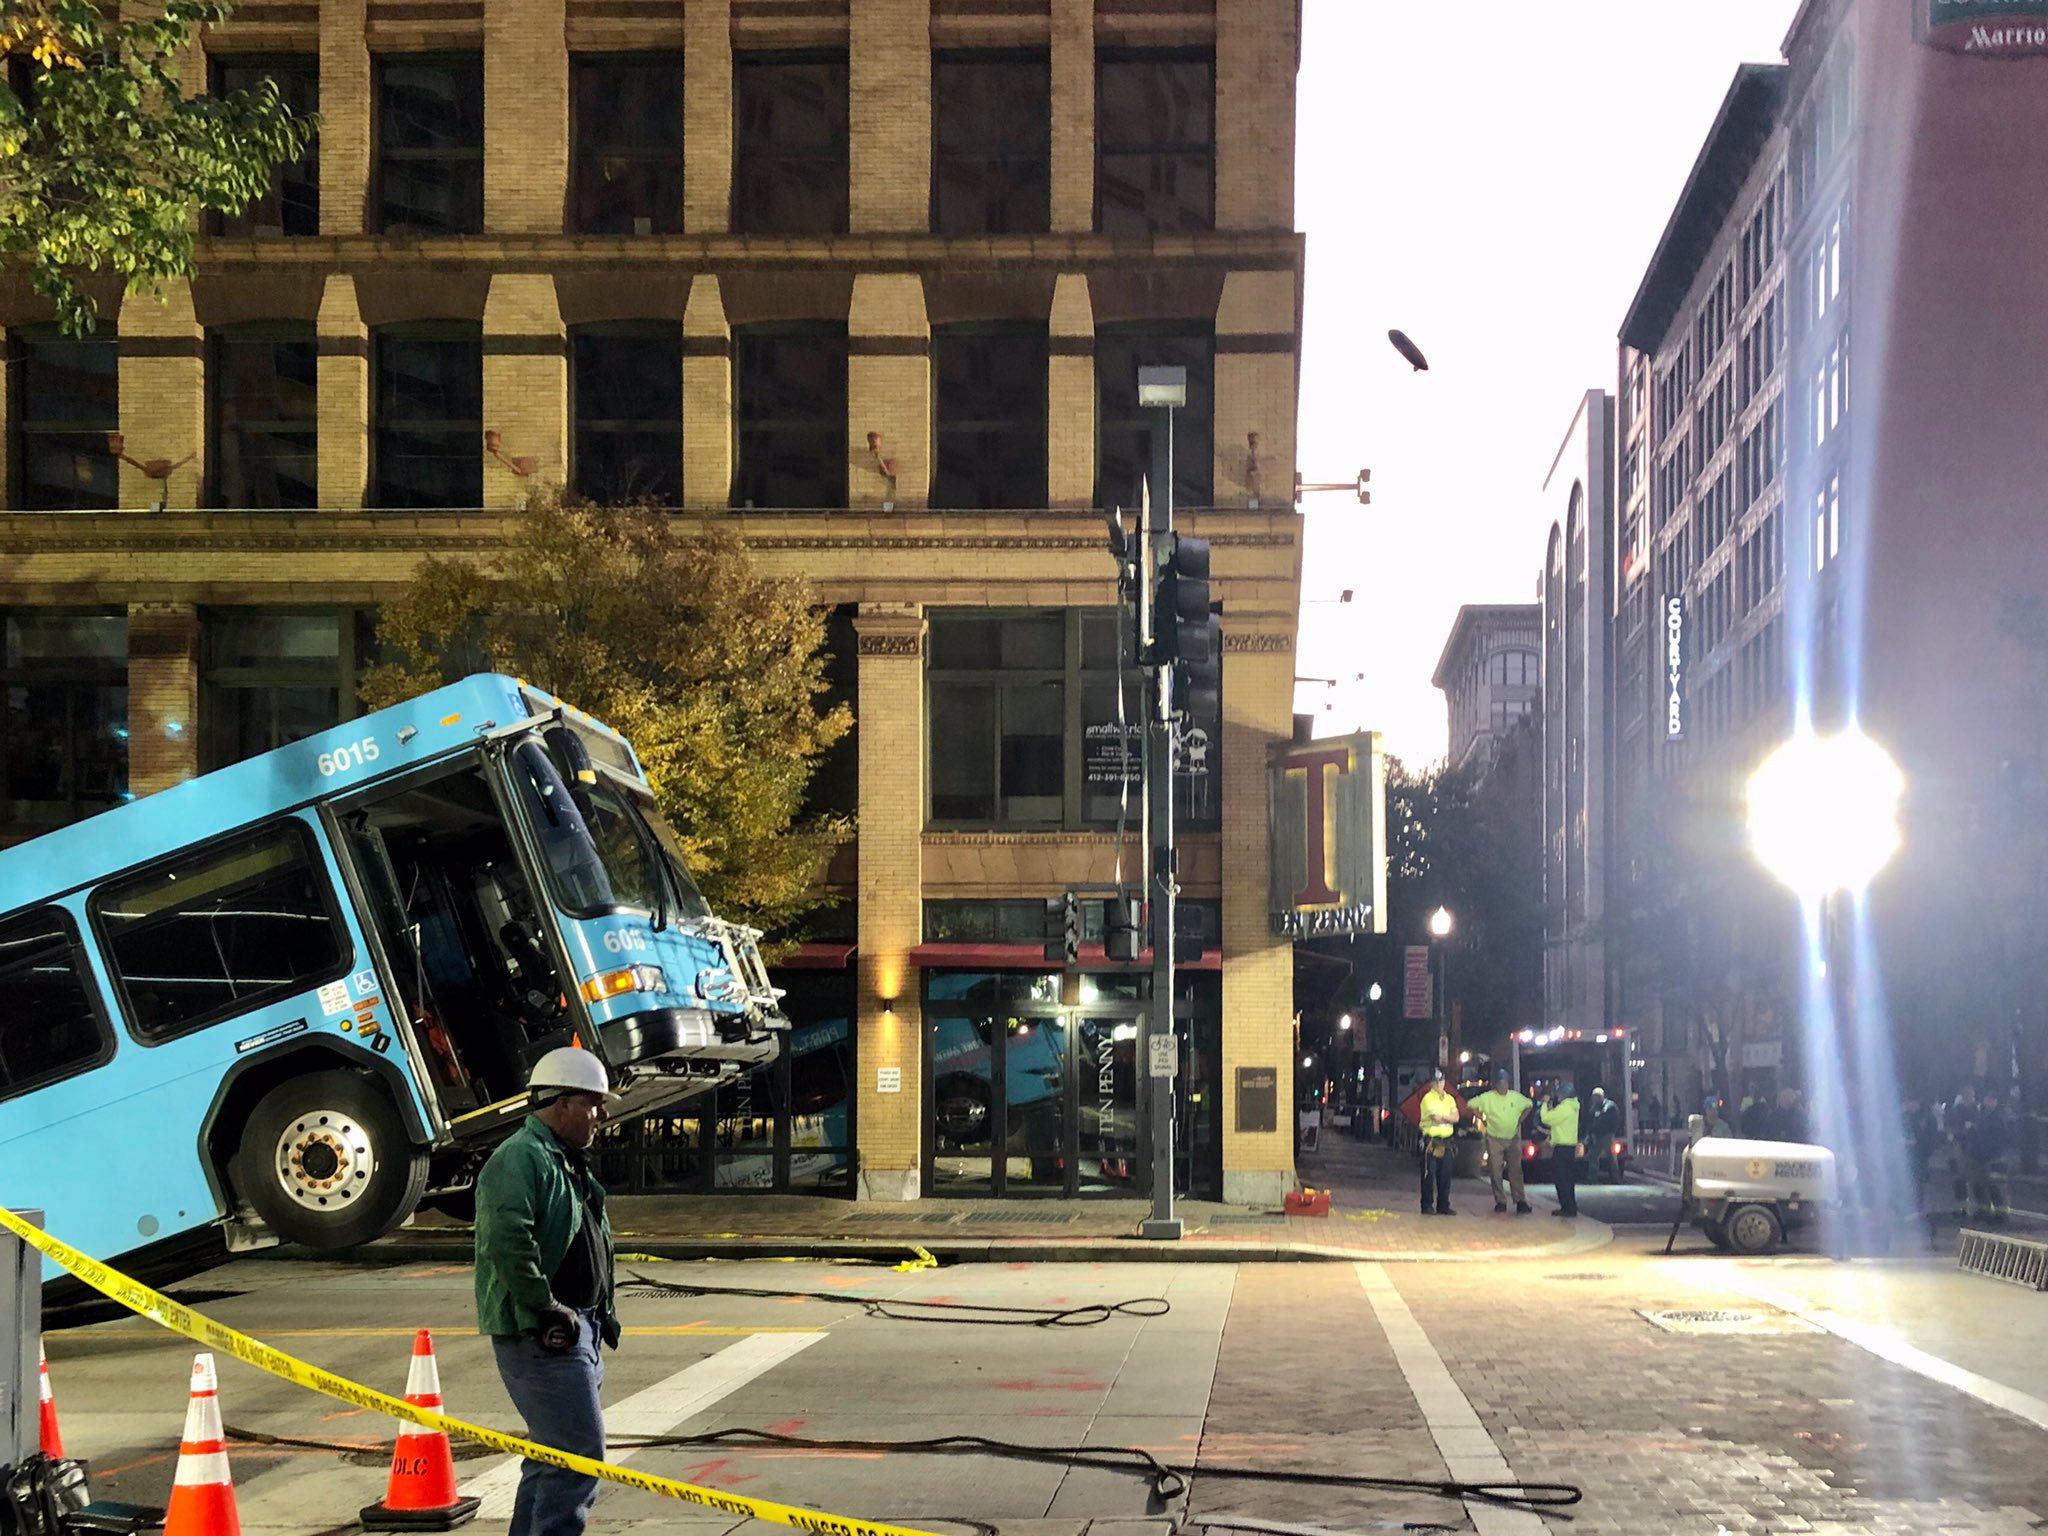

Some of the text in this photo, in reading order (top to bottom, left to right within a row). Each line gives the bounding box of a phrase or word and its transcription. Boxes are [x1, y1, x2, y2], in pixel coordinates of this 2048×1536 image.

[1668, 598, 1682, 734] COURTYARD
[318, 736, 380, 777] 6015
[1098, 1034, 1114, 1134] TEN PENNY
